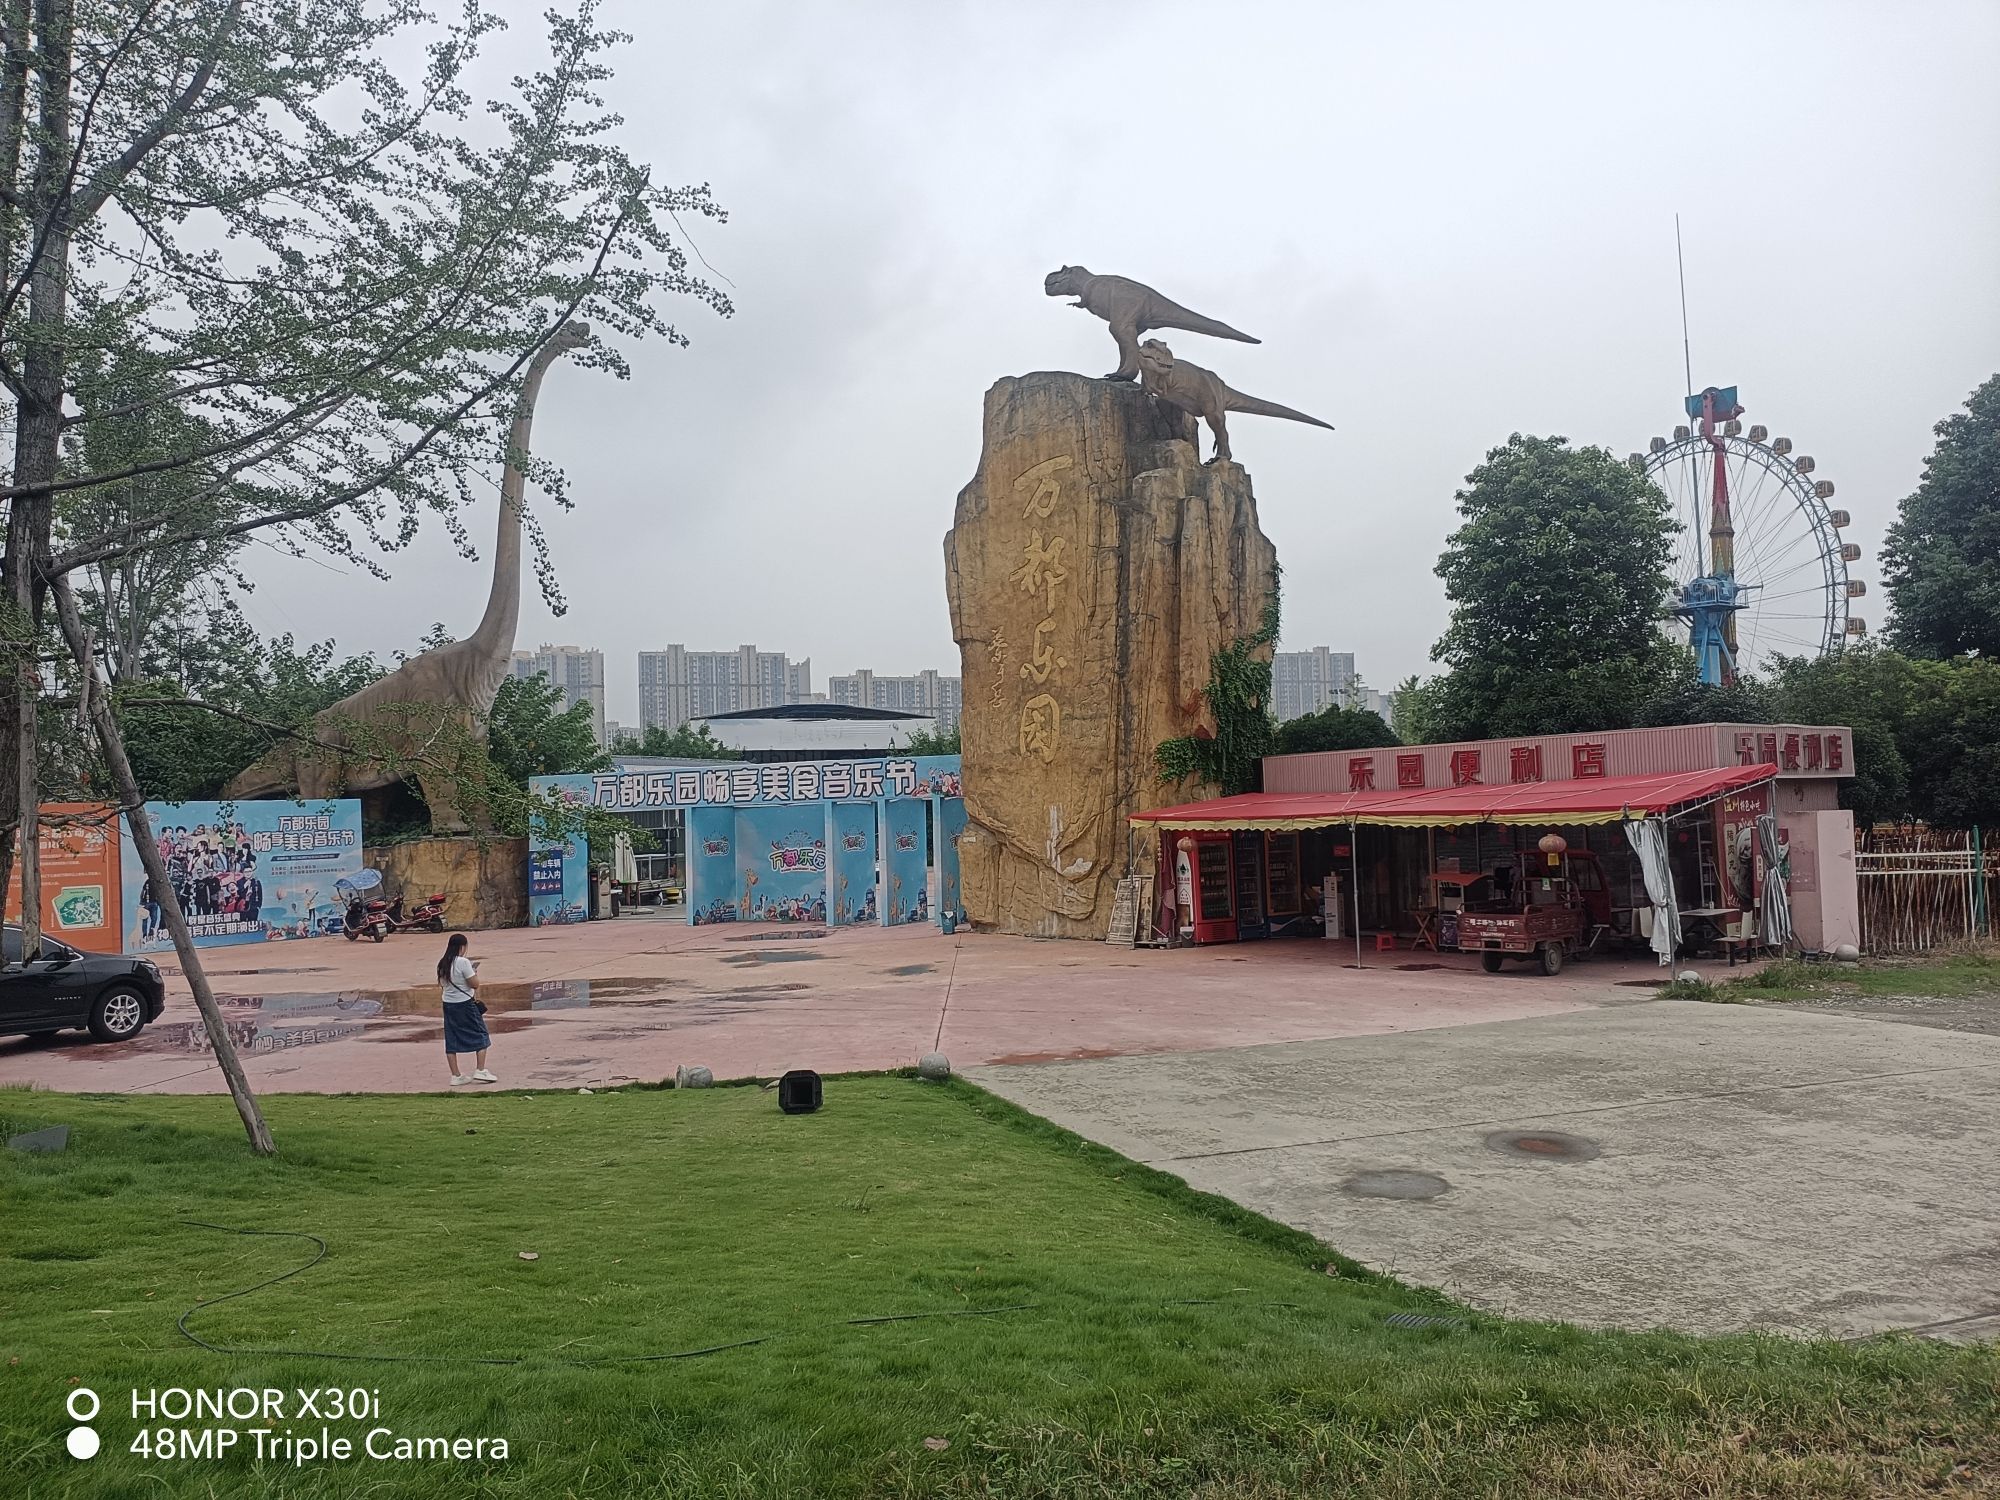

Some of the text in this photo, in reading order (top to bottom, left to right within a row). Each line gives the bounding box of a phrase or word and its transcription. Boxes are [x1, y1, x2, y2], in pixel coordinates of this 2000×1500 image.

[1009, 454, 1074, 765] 万都乐园
[1734, 732, 1843, 770] 乐园便利店
[1349, 743, 1605, 791] 乐园便利店
[592, 760, 917, 808] 万都乐园畅享美食音乐节
[278, 815, 331, 832] 万都乐园
[253, 830, 355, 852] 畅享美食音乐节
[533, 870, 561, 880] 禁止入内
[770, 849, 826, 871] 万都乐园
